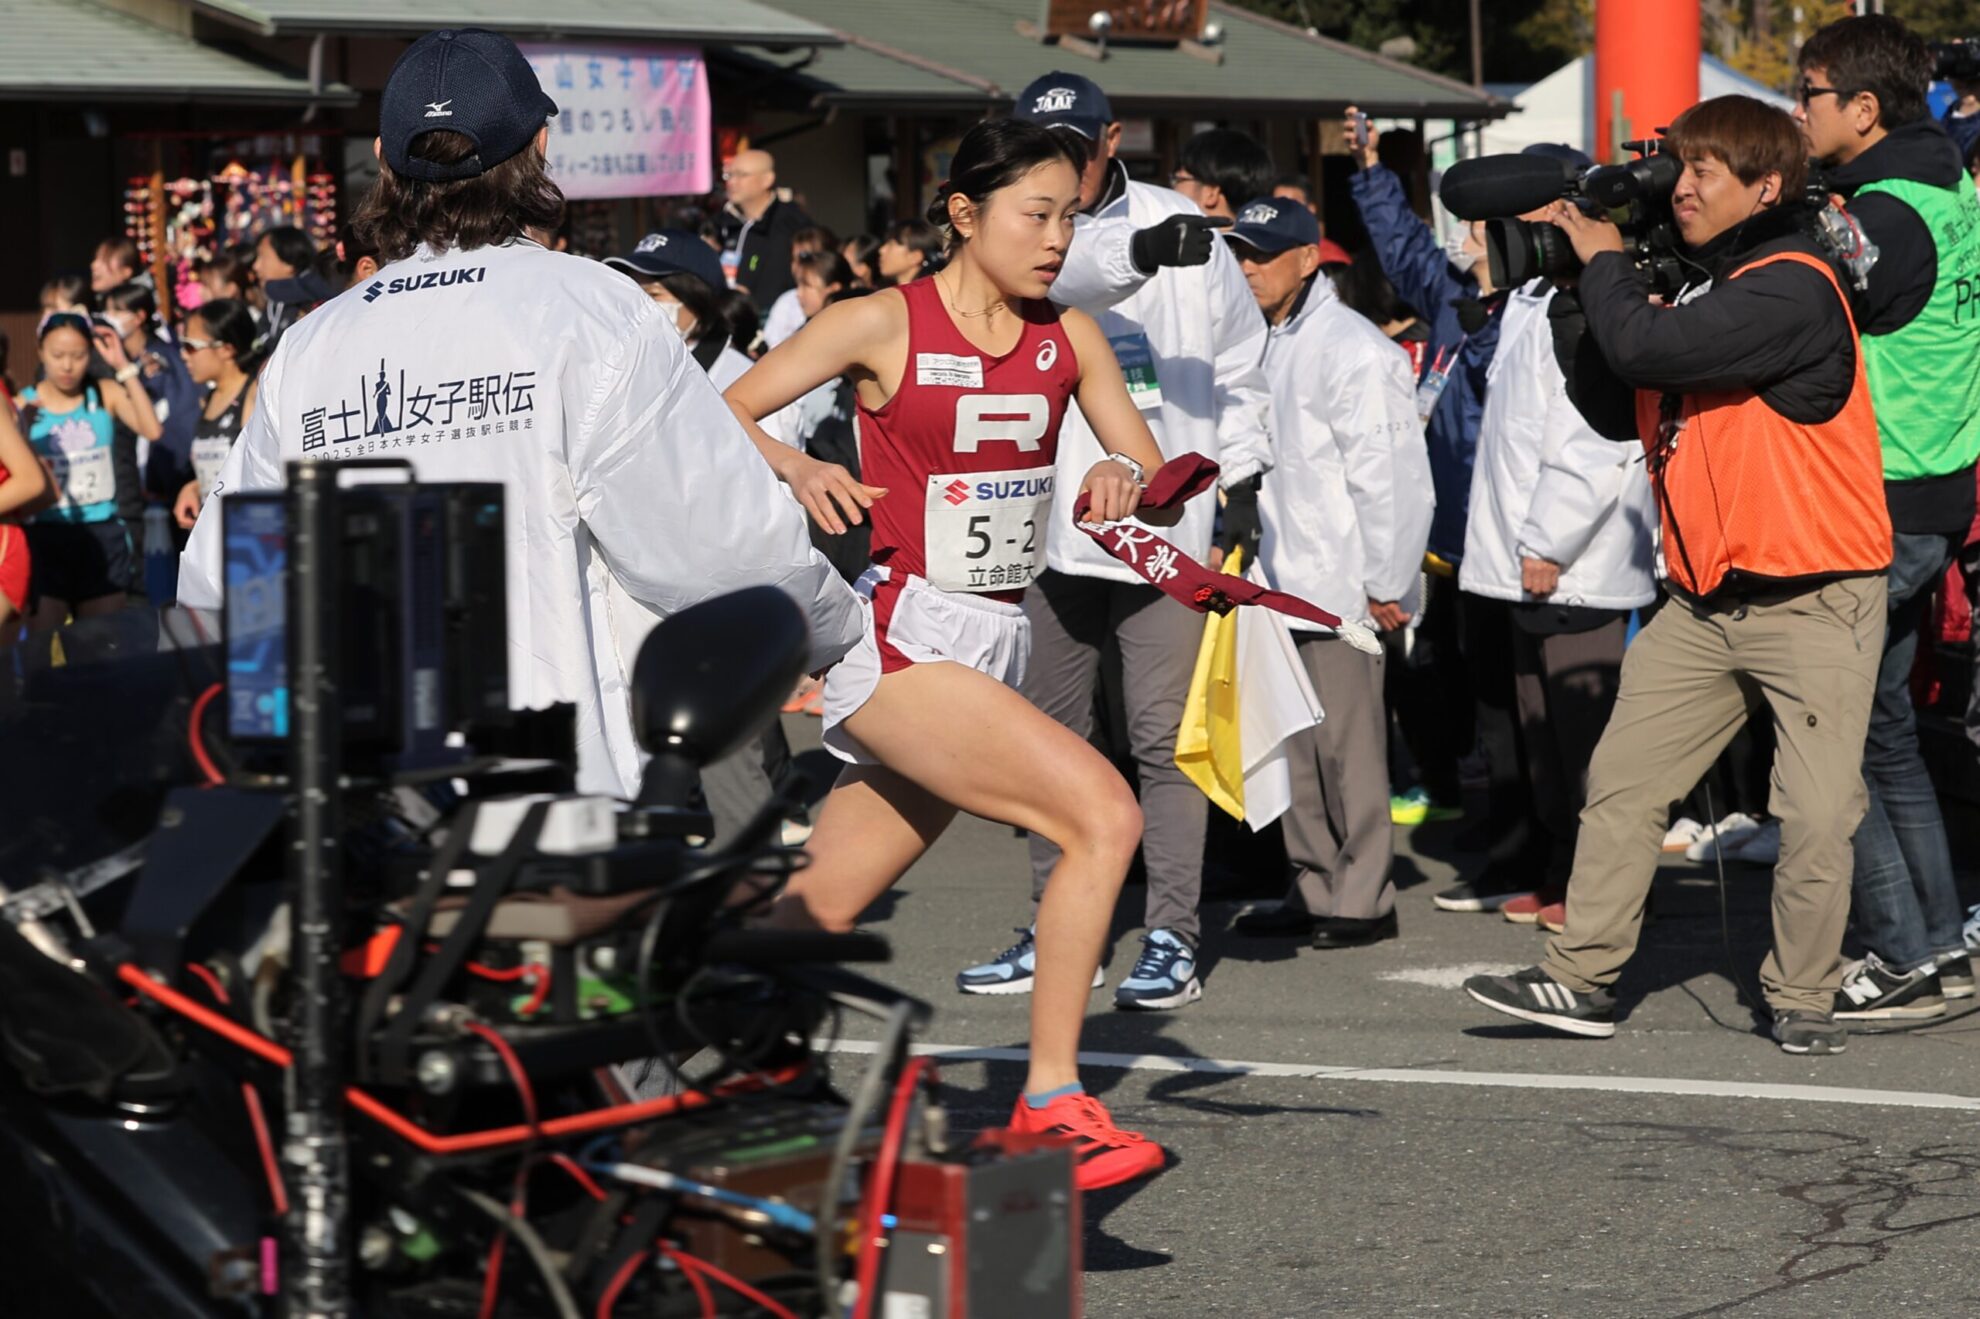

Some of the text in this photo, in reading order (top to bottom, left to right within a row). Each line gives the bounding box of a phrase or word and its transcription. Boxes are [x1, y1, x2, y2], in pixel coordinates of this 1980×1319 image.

[534, 55, 696, 90] 山女子駅伝
[387, 267, 486, 294] SUZUKI
[301, 358, 536, 452] 富士山女子駅伝
[953, 393, 1050, 453] R
[976, 476, 1053, 500] SUZUKI
[967, 561, 1036, 587] 立命館大
